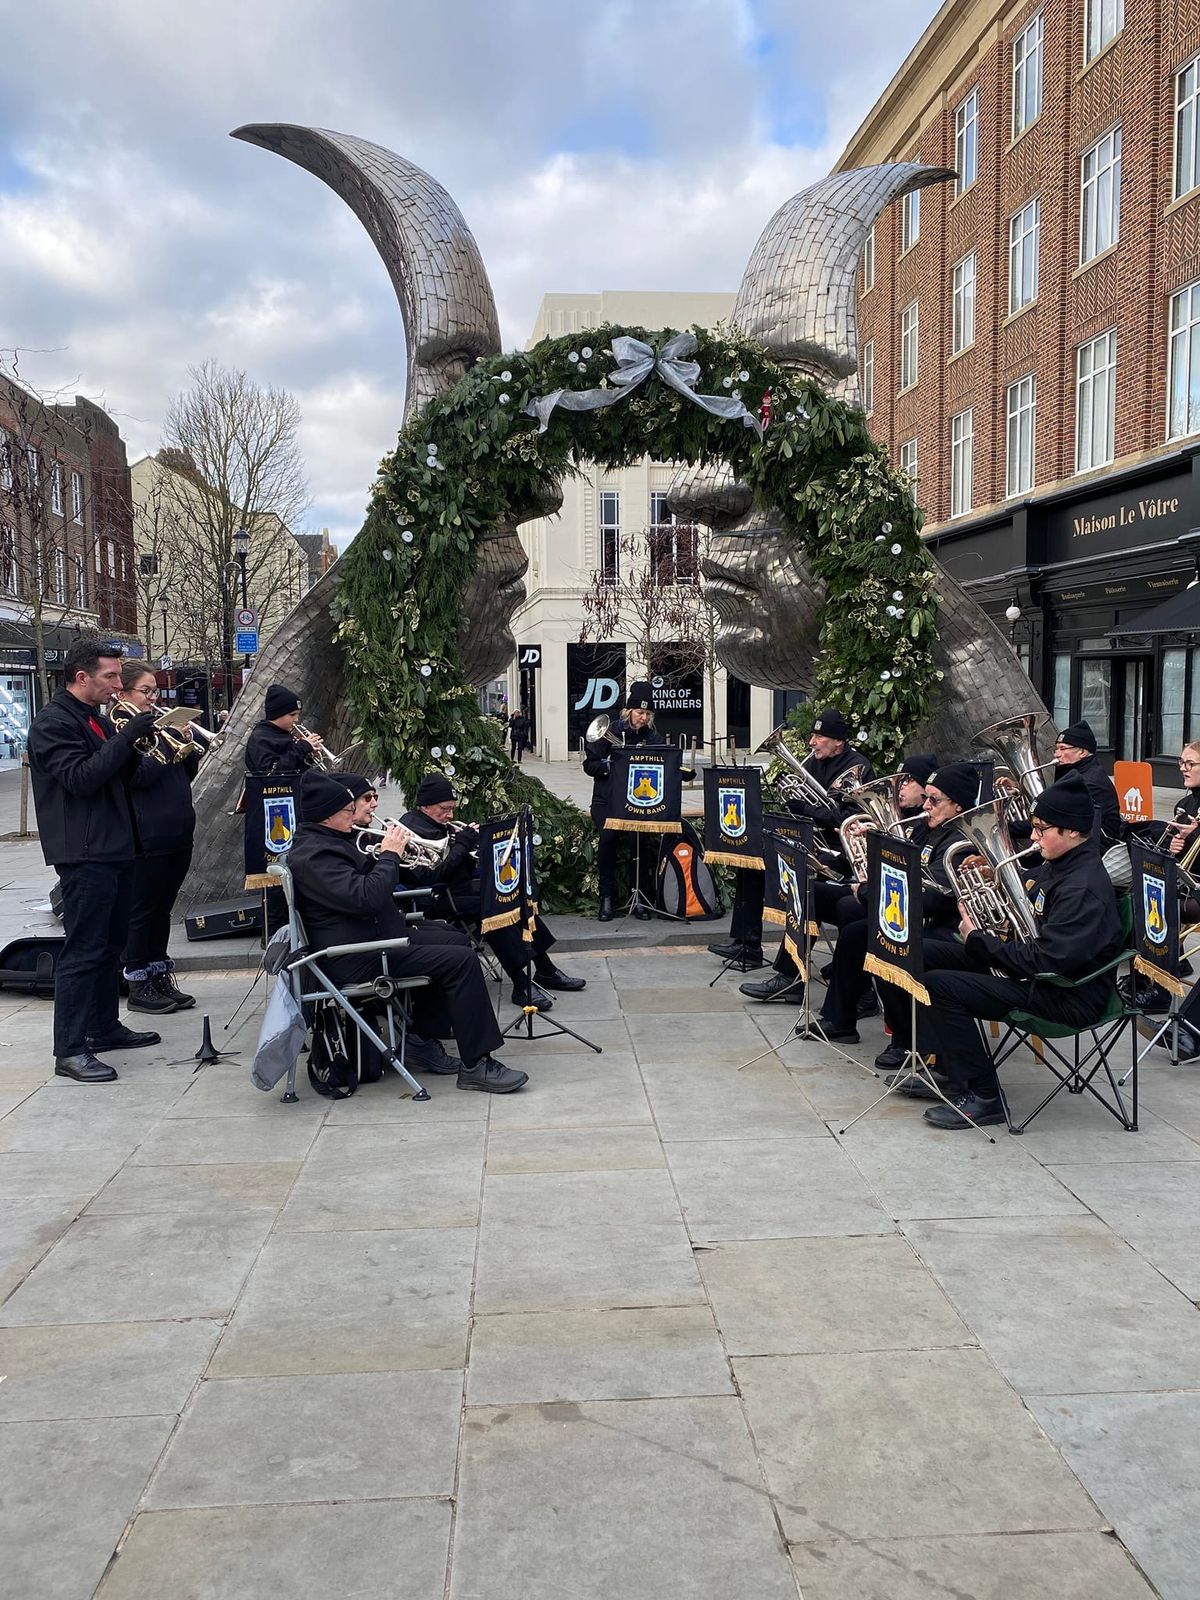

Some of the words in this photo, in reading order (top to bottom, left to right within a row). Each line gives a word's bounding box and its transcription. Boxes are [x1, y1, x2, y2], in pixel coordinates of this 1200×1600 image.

[1073, 514, 1115, 537] Maison
[1120, 506, 1136, 526] Le
[1139, 498, 1178, 520] Vôtre
[520, 649, 540, 664] JD
[574, 678, 620, 711] JD
[652, 689, 676, 699] KING
[679, 688, 692, 698] OF
[653, 699, 702, 710] TRAINERS
[262, 786, 293, 795] AMPTHILL
[624, 803, 645, 815] TOWN
[646, 804, 667, 815] BAND
[1136, 814, 1148, 822] EAT
[264, 851, 278, 863] TOW
[786, 910, 799, 933] TOW
[876, 930, 897, 955] TOWN
